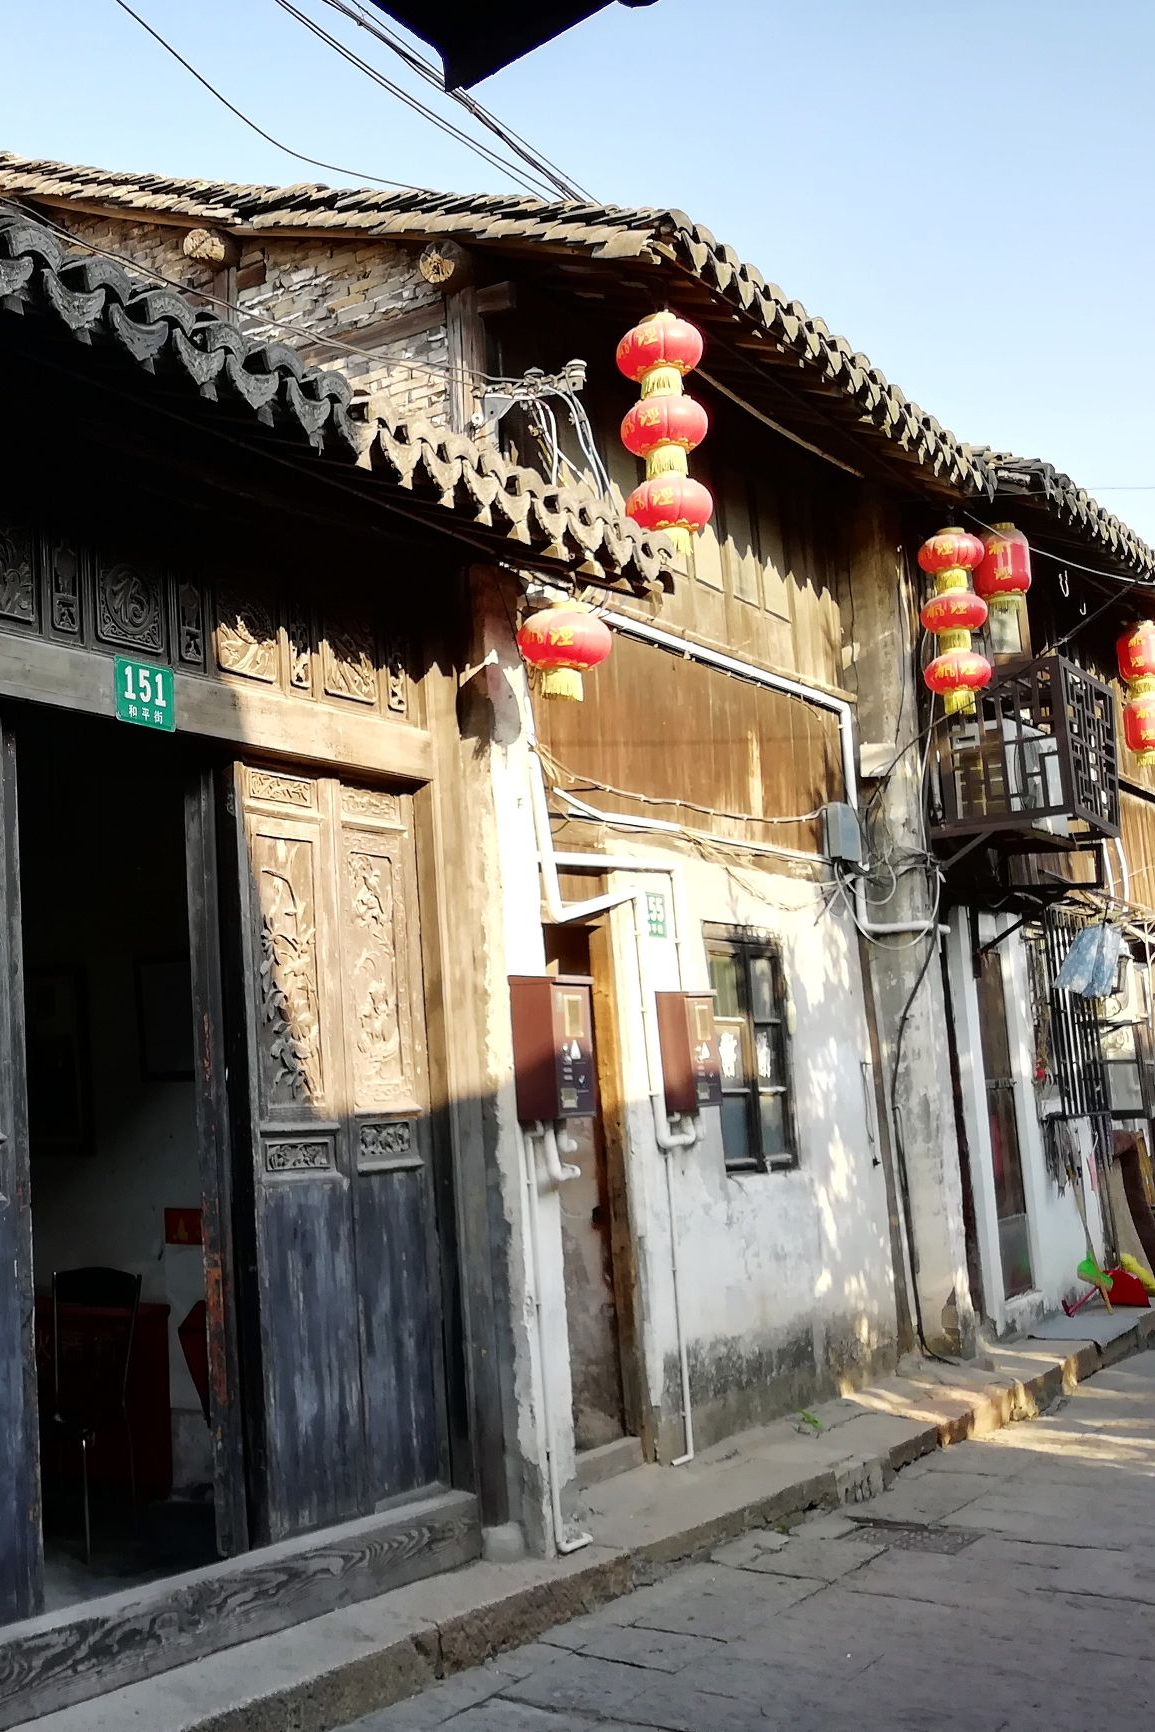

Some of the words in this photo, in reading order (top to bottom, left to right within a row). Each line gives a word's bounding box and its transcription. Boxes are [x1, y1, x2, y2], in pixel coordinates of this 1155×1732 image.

[124, 665, 166, 708] 151
[128, 704, 163, 725] 和平街
